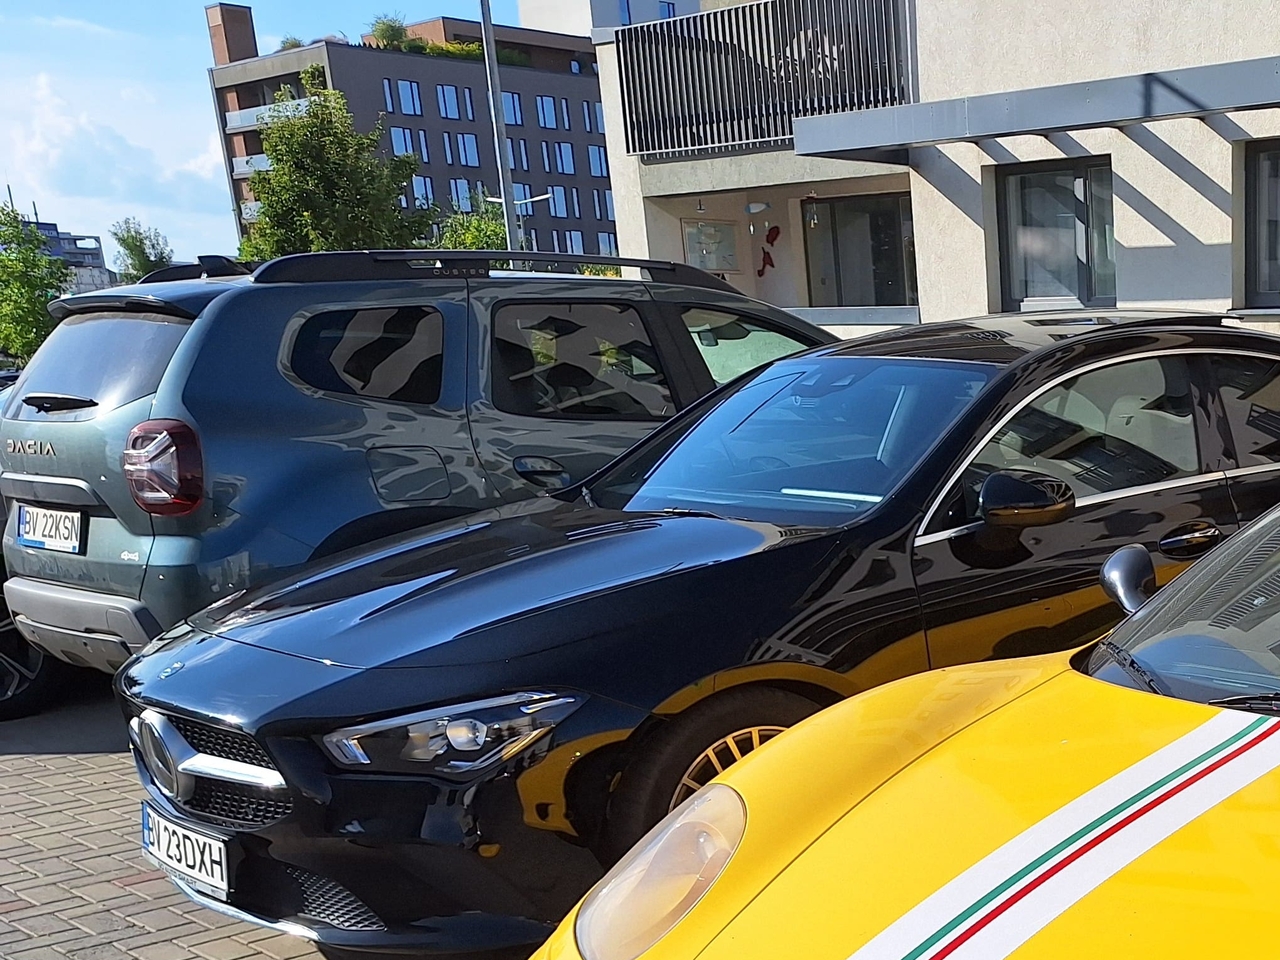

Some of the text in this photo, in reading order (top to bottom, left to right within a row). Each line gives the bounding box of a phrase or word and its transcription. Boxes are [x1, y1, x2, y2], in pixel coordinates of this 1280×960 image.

[7, 439, 57, 457] DACIA
[25, 510, 80, 542] BV 22KSN
[163, 824, 225, 883] 23DXH
